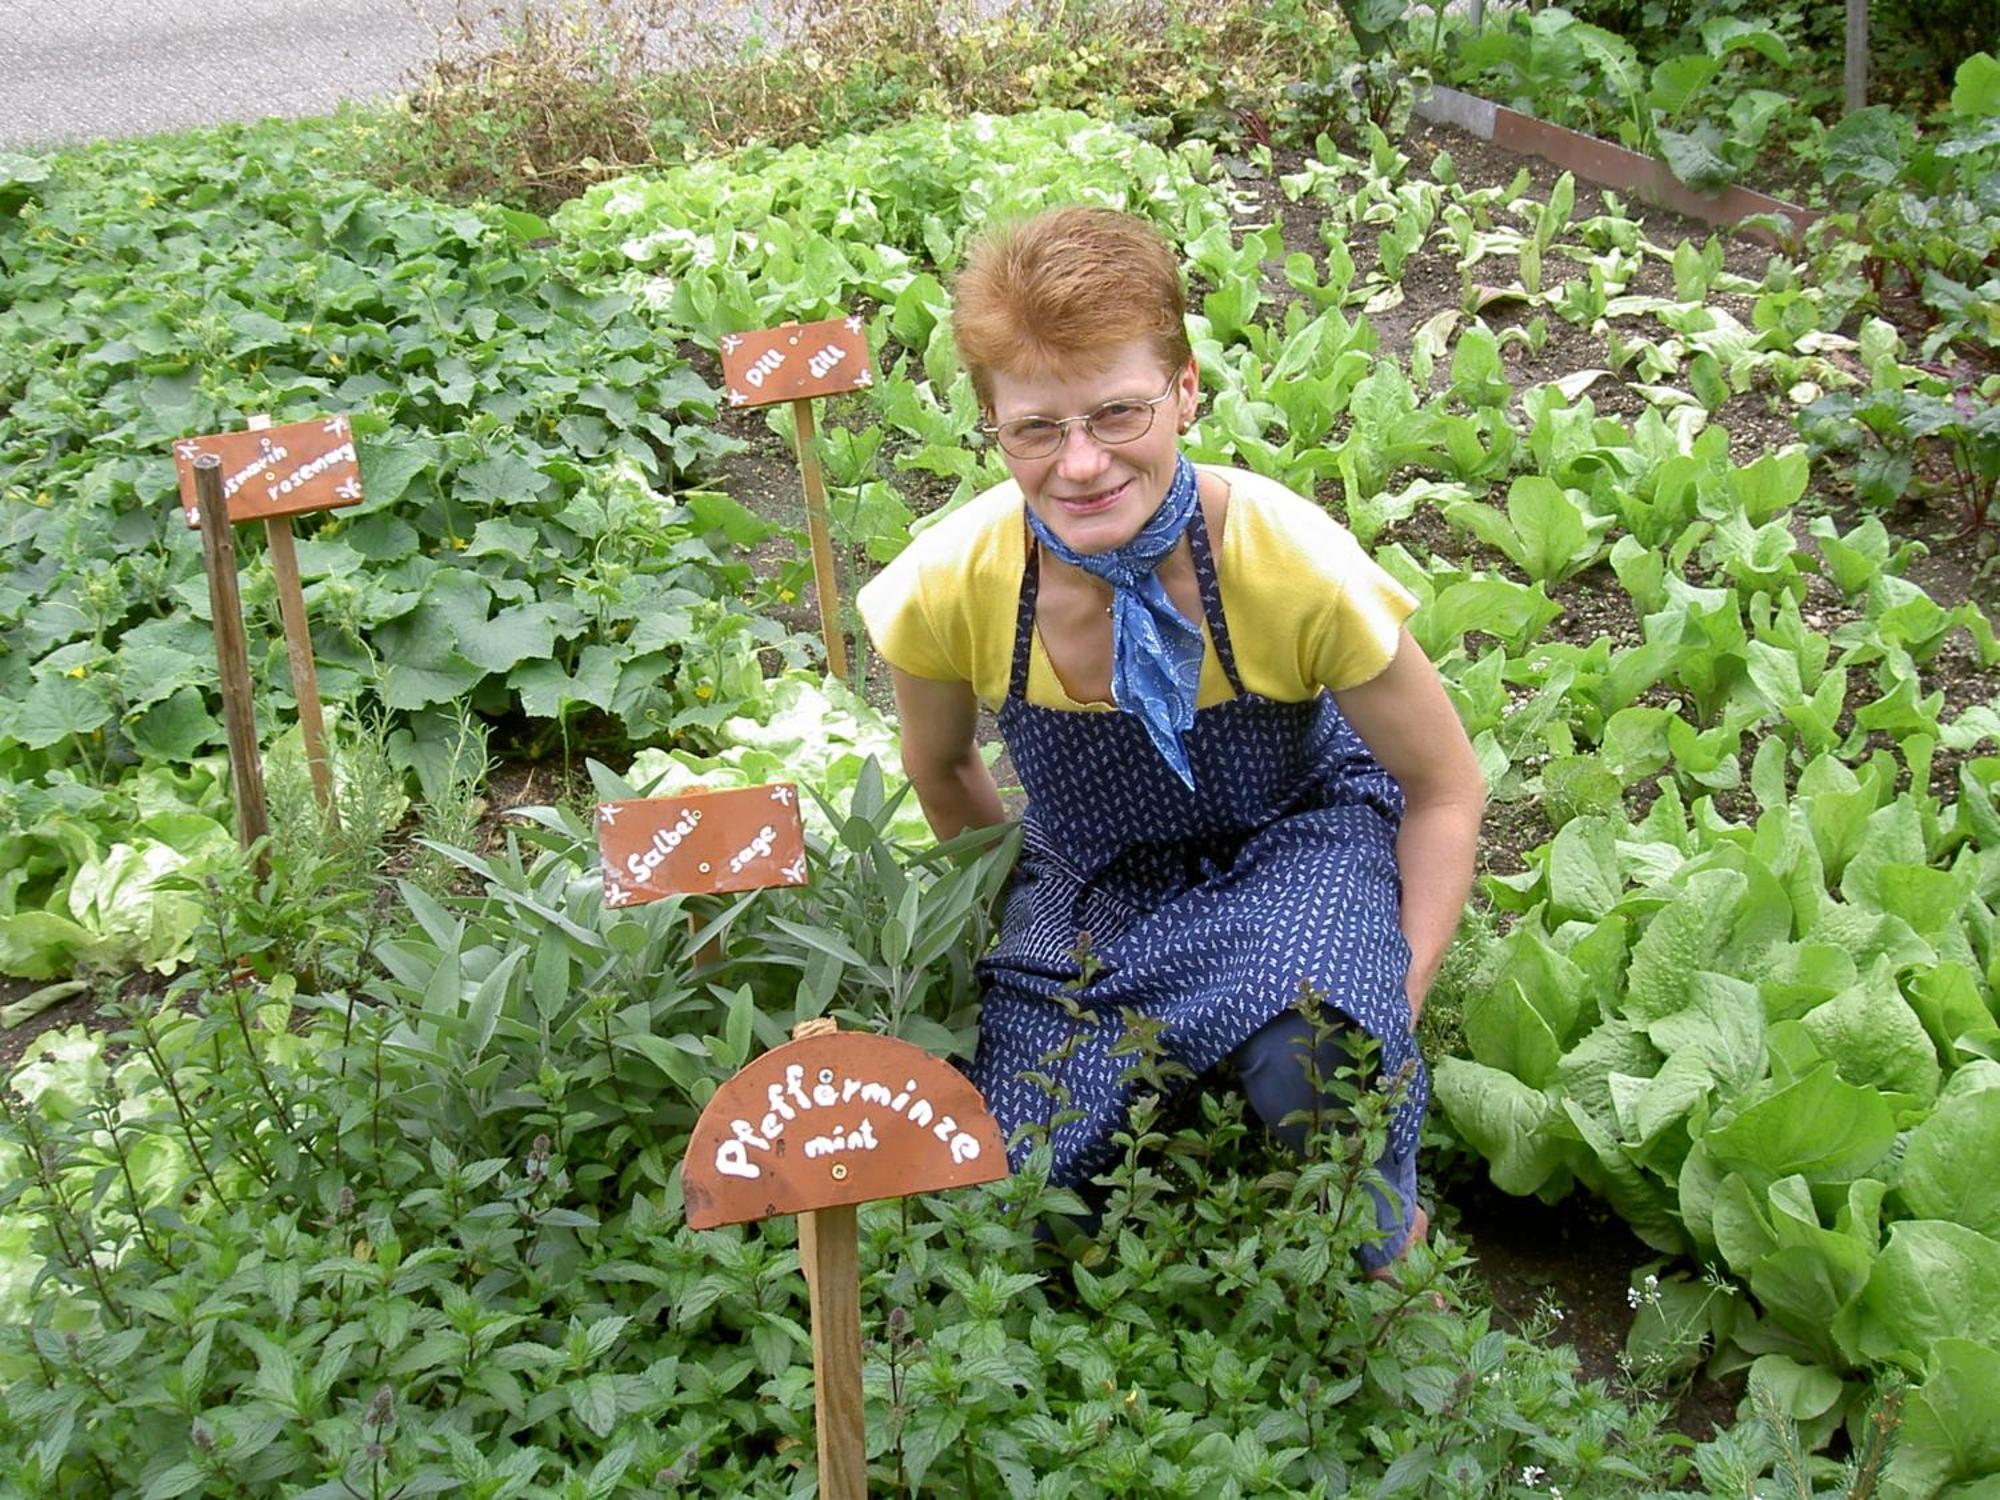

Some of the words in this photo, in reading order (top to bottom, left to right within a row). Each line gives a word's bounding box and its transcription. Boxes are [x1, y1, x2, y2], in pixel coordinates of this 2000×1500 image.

[807, 344, 848, 379] dill
[223, 446, 288, 499] smarin
[267, 442, 357, 501] rosemary
[627, 808, 698, 883] Salbei
[729, 825, 777, 873] sage
[715, 1064, 982, 1179] Pfefferminze
[804, 1117, 879, 1158] mint
